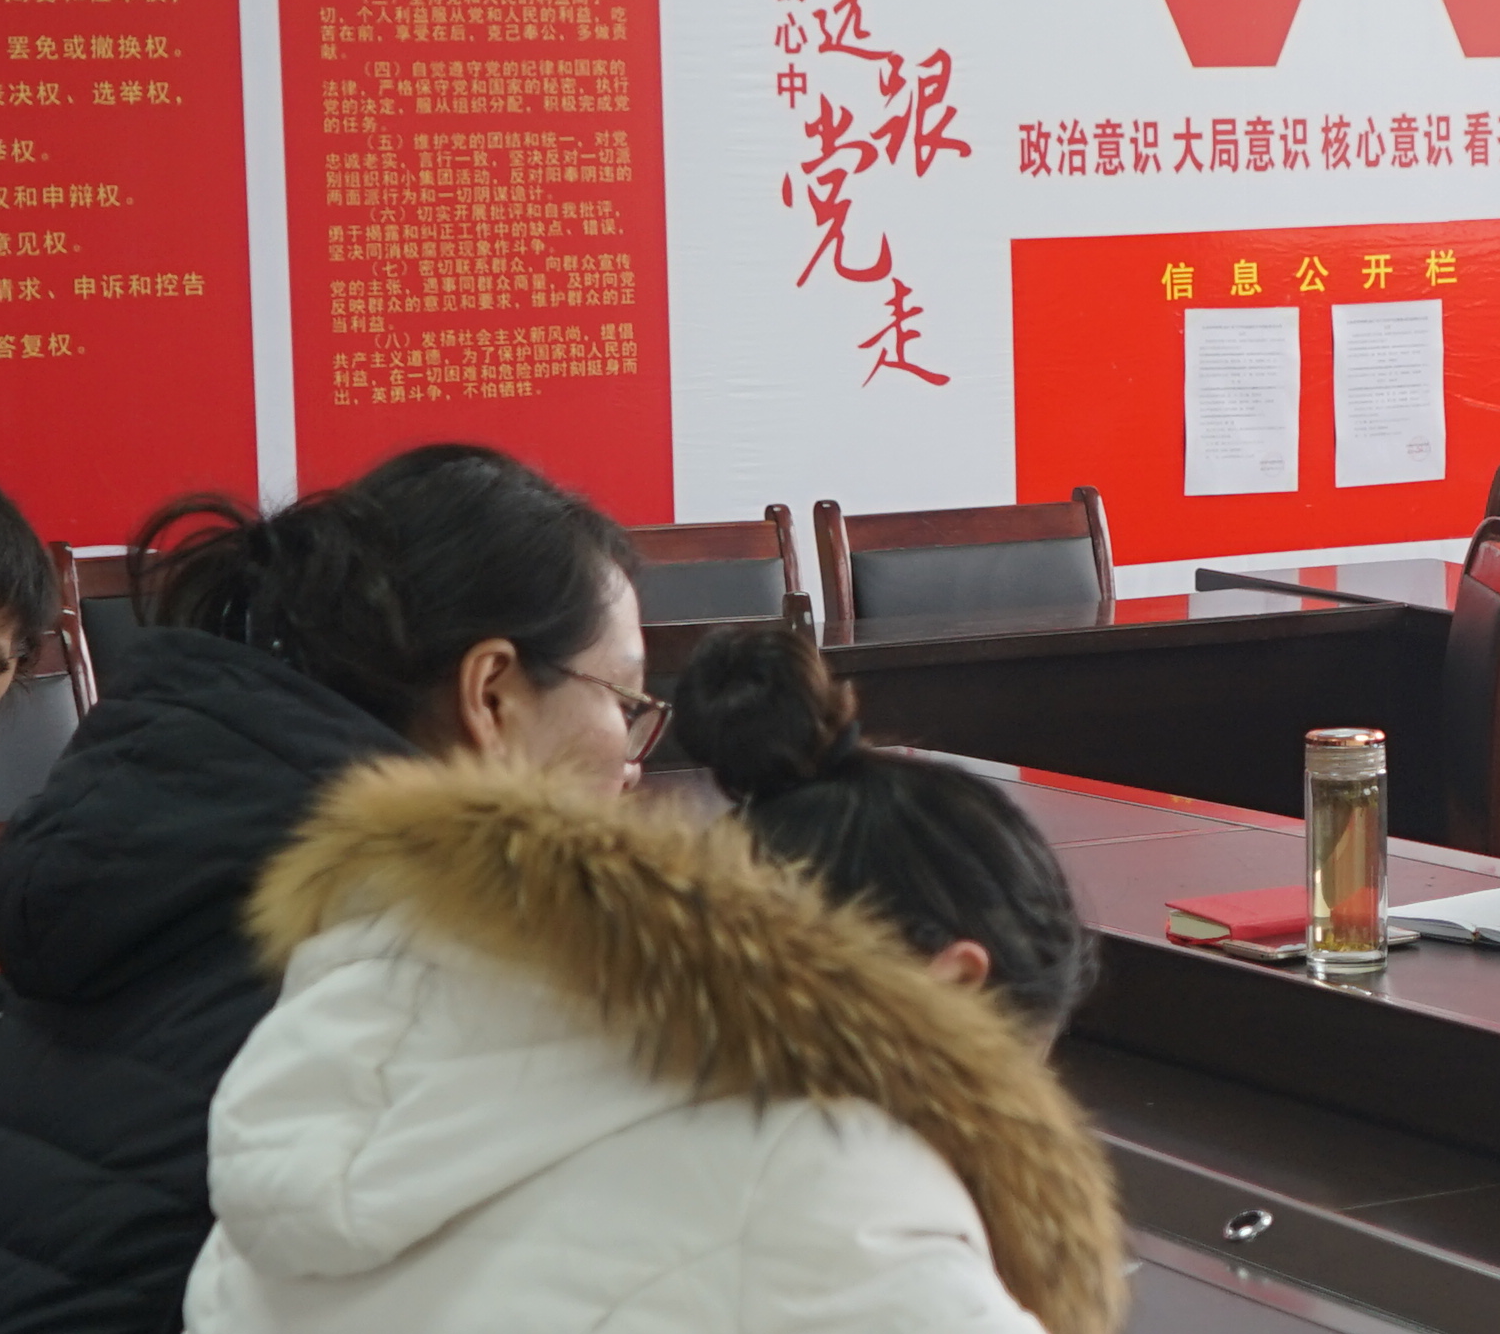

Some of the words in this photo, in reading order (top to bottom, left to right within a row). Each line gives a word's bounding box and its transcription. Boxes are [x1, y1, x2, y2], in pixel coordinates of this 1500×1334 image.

[1020, 120, 1163, 177] 政治意识
[1174, 117, 1311, 173] 大局意识
[1322, 115, 1454, 170] 核心意识
[1163, 251, 1458, 301] 信息公开栏
